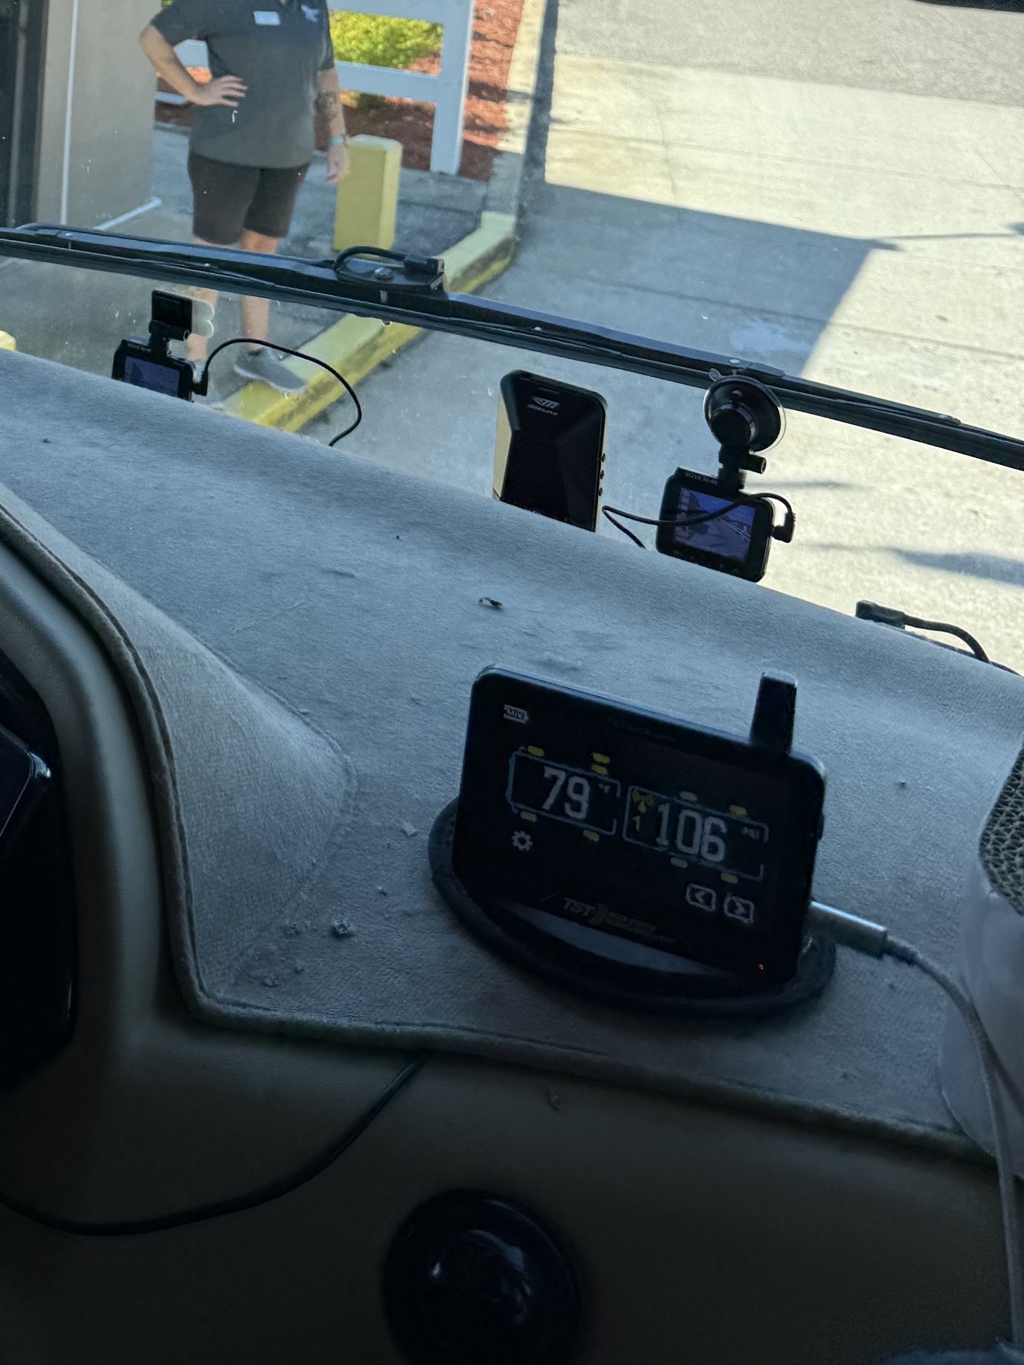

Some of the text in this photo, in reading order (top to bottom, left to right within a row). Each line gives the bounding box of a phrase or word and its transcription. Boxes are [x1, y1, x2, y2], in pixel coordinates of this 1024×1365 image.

[542, 765, 591, 820] 79
[654, 801, 728, 863] 106
[563, 896, 597, 917] TST
